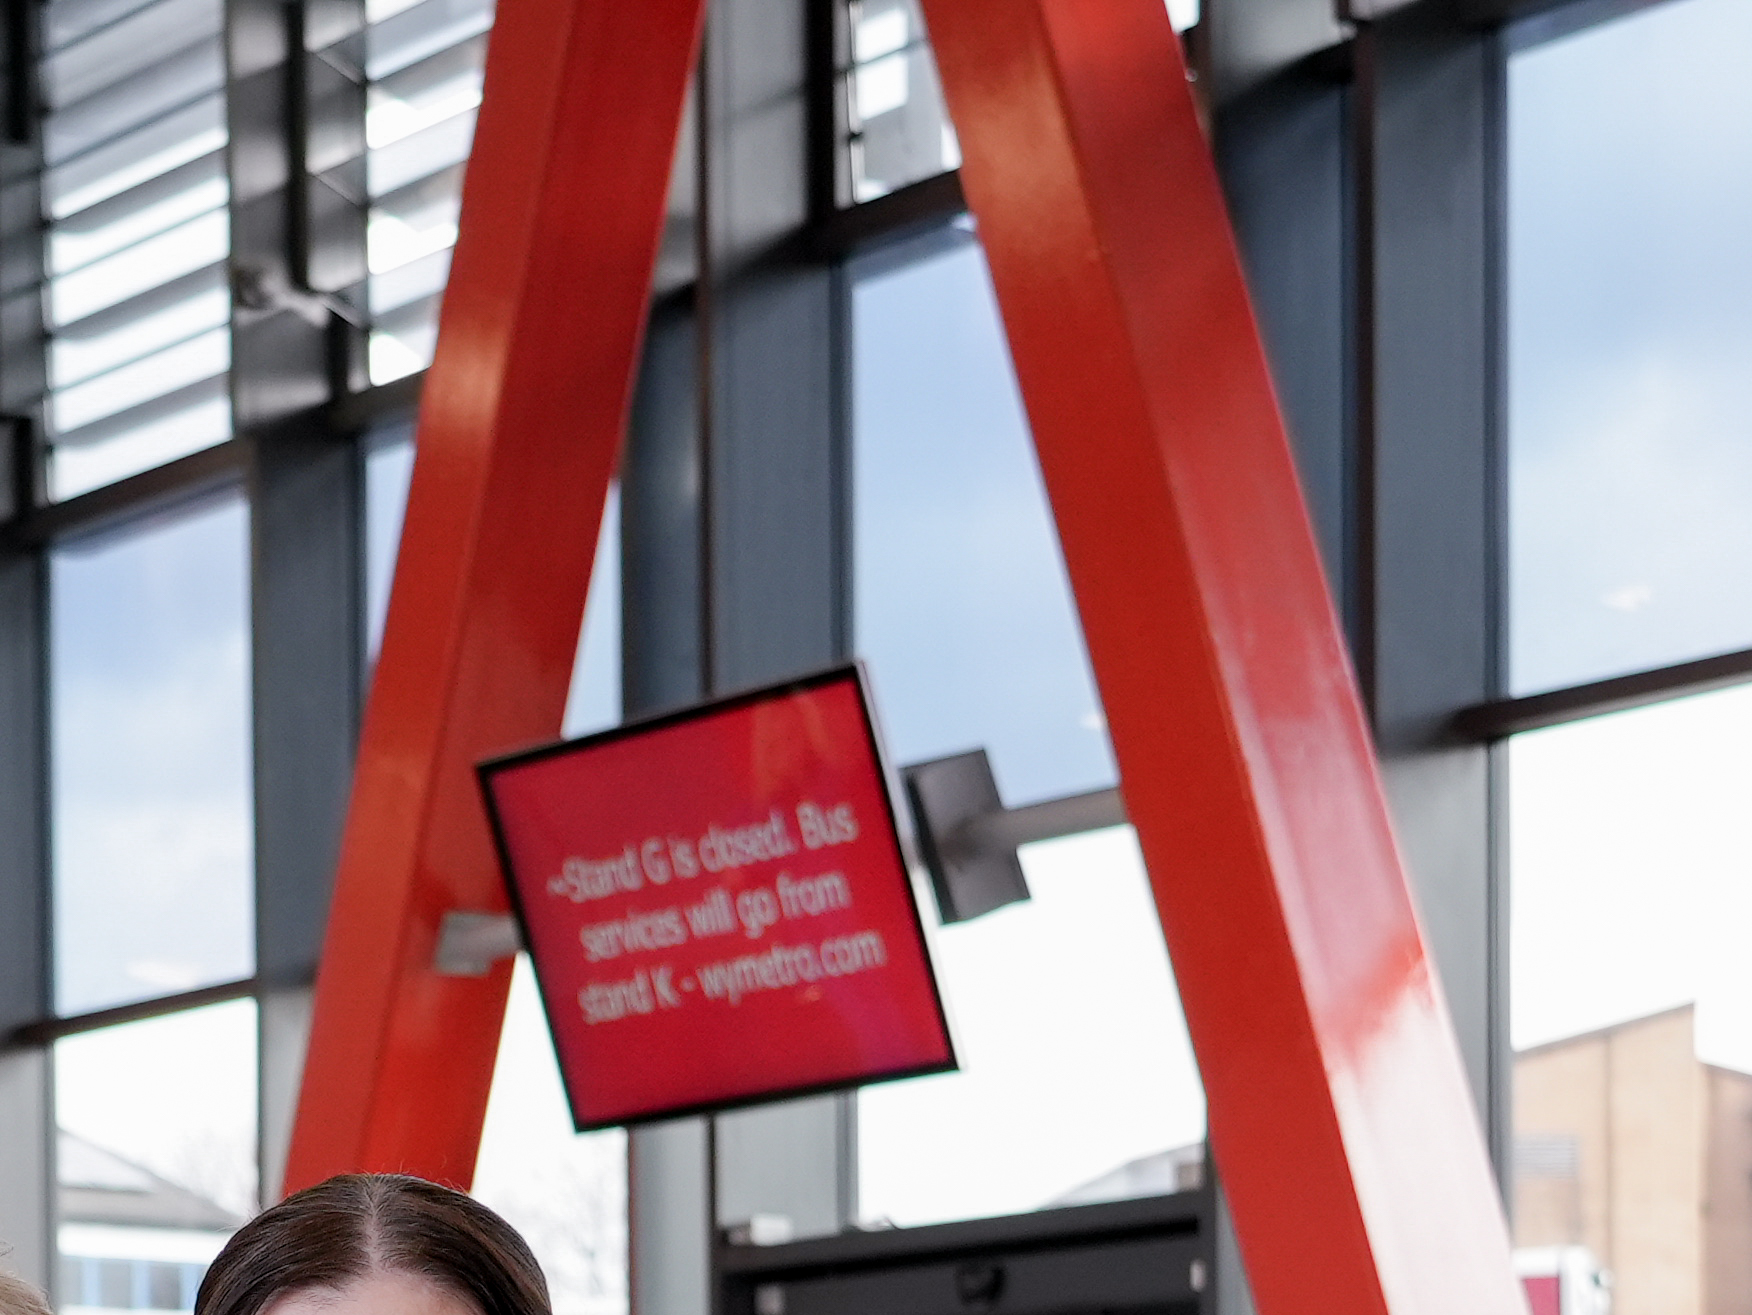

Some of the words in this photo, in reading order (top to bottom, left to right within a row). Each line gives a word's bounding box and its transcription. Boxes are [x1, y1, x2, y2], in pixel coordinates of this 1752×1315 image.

[641, 836, 672, 886] G
[666, 834, 701, 879] is
[795, 800, 860, 850] Bus
[579, 906, 689, 963] services
[684, 886, 738, 940] will
[736, 886, 780, 940] go
[776, 870, 853, 921] from
[578, 966, 655, 1025] stand
[650, 964, 683, 1008] K
[696, 929, 889, 1007] wymetro.com
